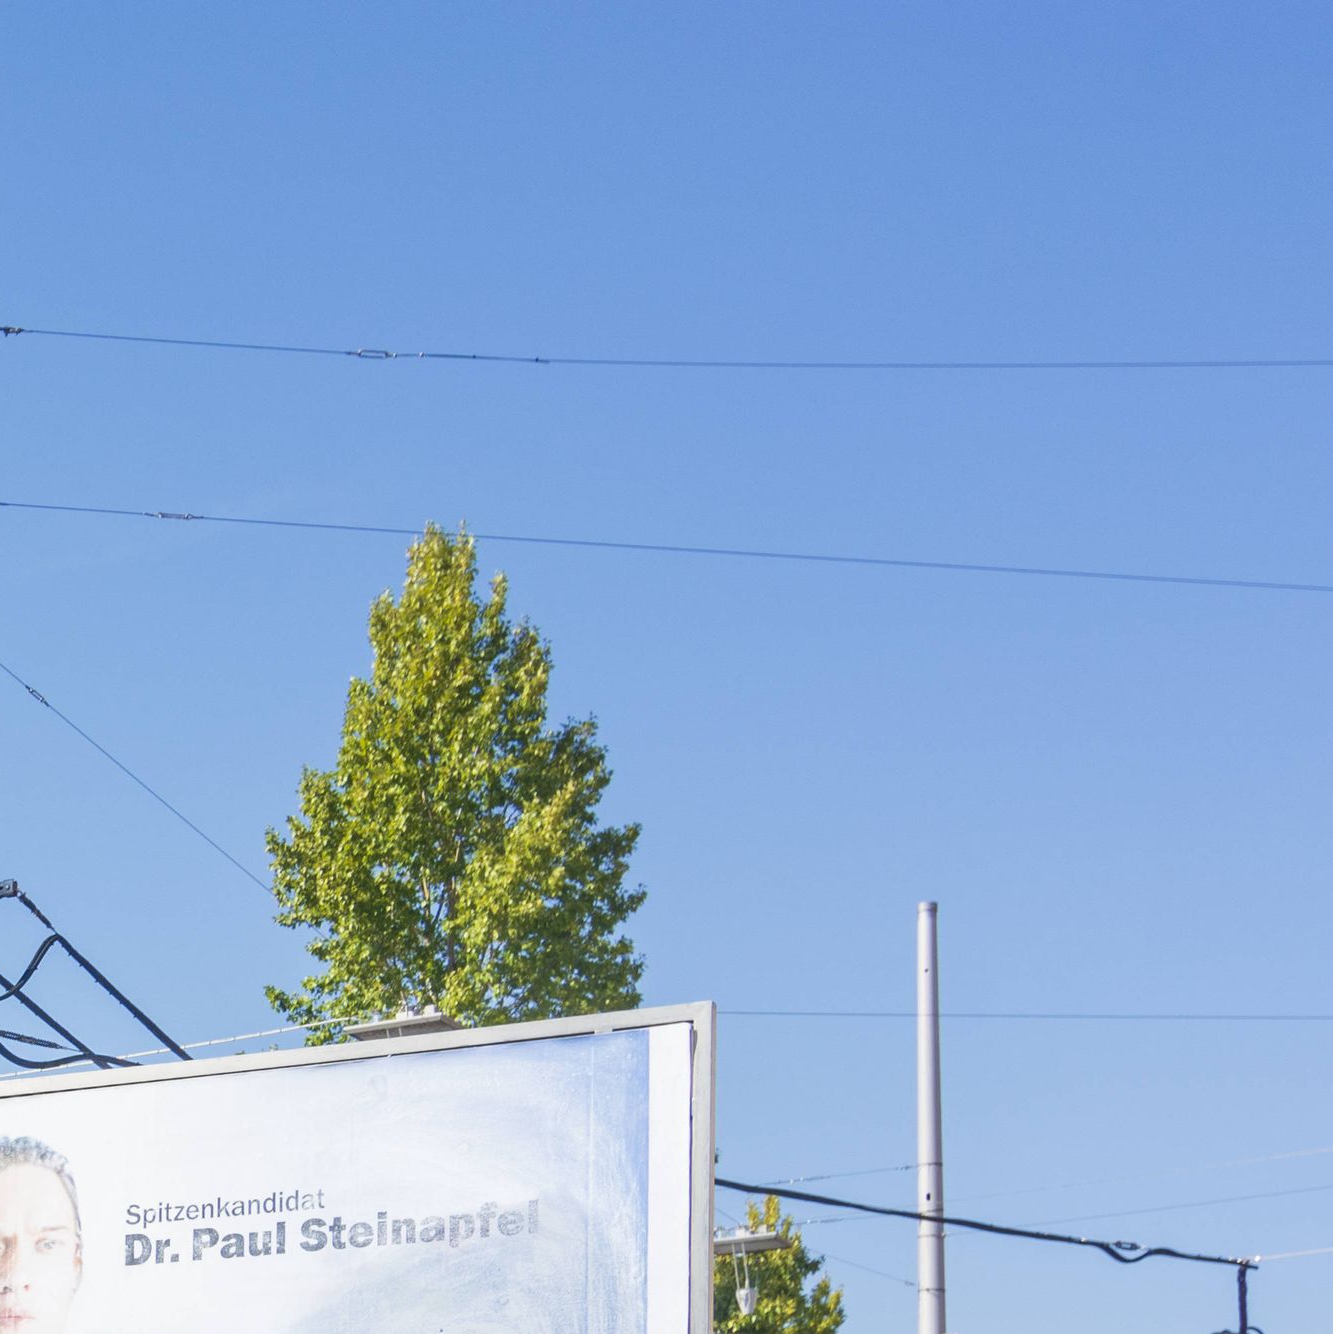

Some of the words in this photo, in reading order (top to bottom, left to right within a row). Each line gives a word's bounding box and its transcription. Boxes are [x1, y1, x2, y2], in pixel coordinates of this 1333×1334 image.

[123, 1232, 180, 1267] Dr.
[191, 1221, 287, 1261] Paul
[298, 1198, 541, 1253] Steinapfel
[125, 1189, 326, 1229] Spitzenkandidat
